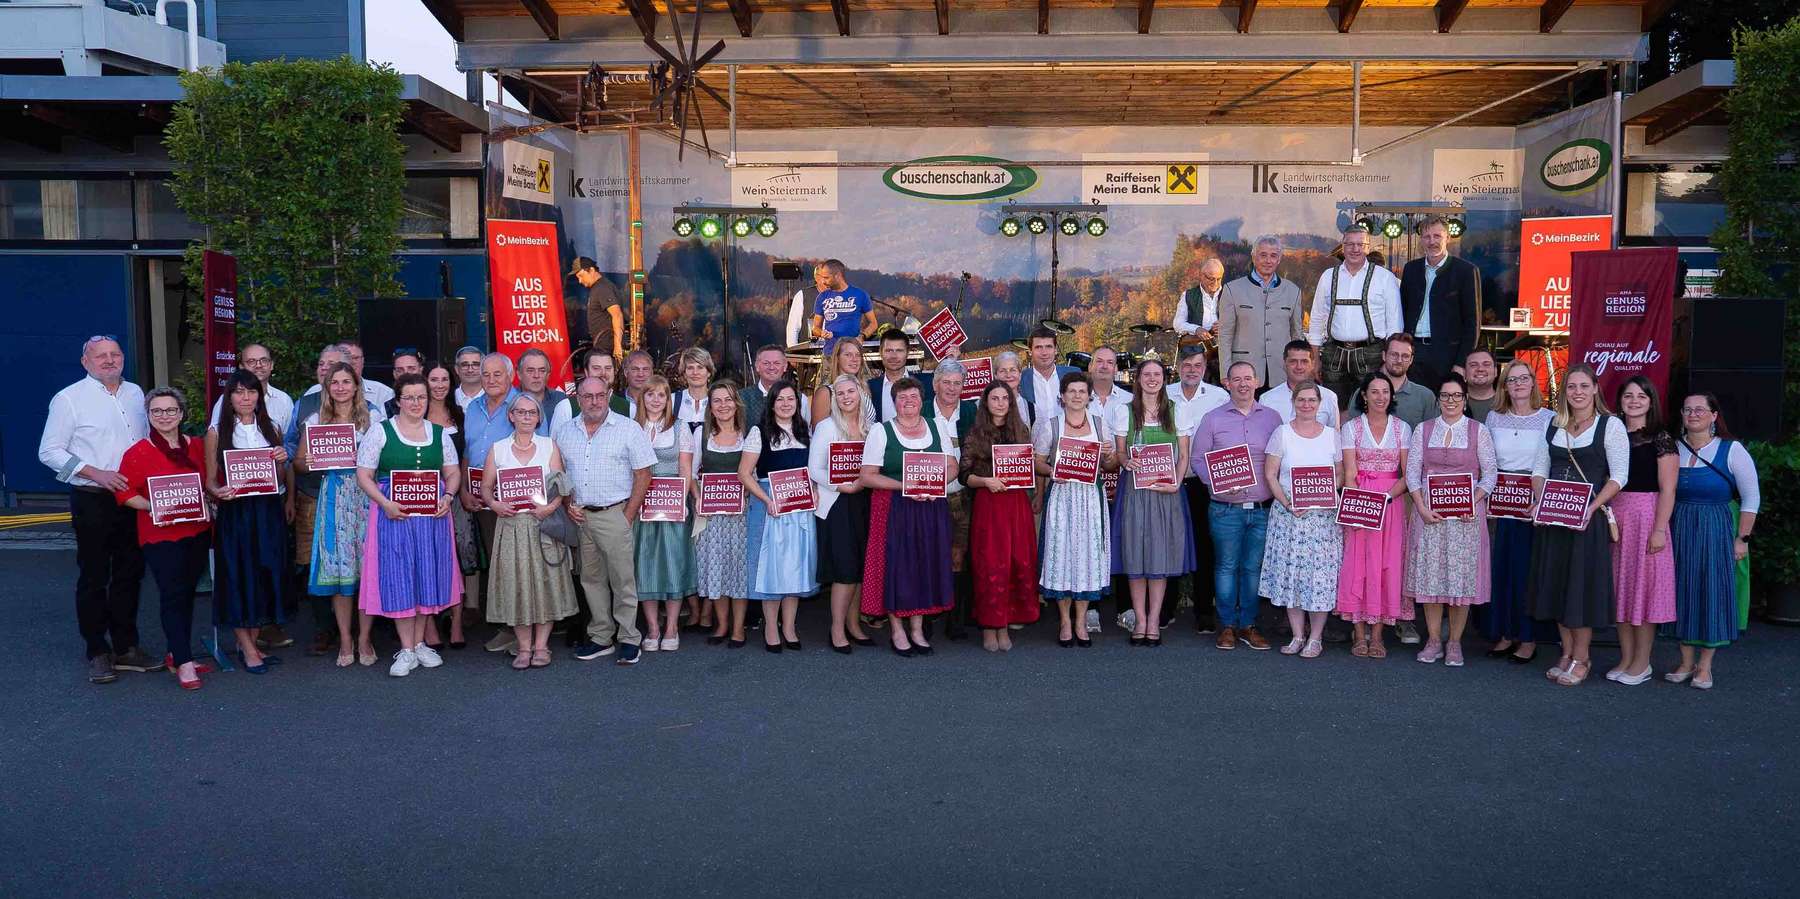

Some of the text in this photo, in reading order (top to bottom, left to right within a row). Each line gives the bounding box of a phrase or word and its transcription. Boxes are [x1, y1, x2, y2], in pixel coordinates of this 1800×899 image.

[1547, 154, 1598, 177] buschenschank.at
[900, 171, 1006, 184] buschenschank.at
[1106, 172, 1161, 182] Raiffeisen
[1283, 172, 1390, 183] Landwirtschaftskammer
[508, 176, 536, 190] Meine Bank
[1443, 183, 1469, 194] Wein
[742, 185, 828, 195] Wein Steiermark
[1094, 184, 1160, 194] Meine Bank
[1283, 184, 1332, 194] Steiermark
[508, 236, 550, 246] MeinBezirk
[1545, 233, 1600, 242] MeinBezirk
[514, 278, 542, 292] AUS
[1546, 277, 1570, 292] AU
[512, 295, 548, 309] LIEBE
[1606, 296, 1646, 304] GENUSS
[1606, 304, 1644, 312] REGION
[518, 312, 546, 326] ZUR
[1544, 313, 1570, 327] ZU
[504, 328, 564, 344] REGION.
[927, 318, 954, 343] GENUSS
[932, 326, 958, 350] REGION
[1584, 340, 1660, 376] regionale
[966, 370, 990, 378] NUSS
[964, 378, 990, 386] EGION
[312, 436, 352, 446] GENUSS
[312, 445, 352, 454] REGION
[1060, 450, 1096, 460] GENUSS
[1060, 458, 1095, 469] REGION
[1142, 456, 1171, 465] ENUSS
[1211, 456, 1248, 471] GENUSS
[230, 462, 272, 472] GENUSS
[906, 465, 944, 473] GENUSS
[998, 466, 1030, 474] REGION
[1212, 465, 1250, 479] REGION
[232, 470, 272, 480] REGION
[394, 484, 436, 492] GENUSS
[502, 478, 542, 490] GENUSS
[774, 480, 808, 492] GENUSS
[154, 487, 198, 498] GENUSS
[504, 487, 542, 498] REGION
[776, 488, 810, 500] REGION
[1432, 487, 1470, 496] GENUSS
[1492, 486, 1530, 496] GENUSS
[156, 496, 199, 508] REGION
[1344, 498, 1382, 510] GENUSS
[1432, 496, 1470, 504] REGION
[1492, 494, 1529, 504] REGION
[1544, 493, 1586, 504] GENUSS
[1342, 505, 1380, 516] REGION
[1542, 501, 1583, 511] REGION
